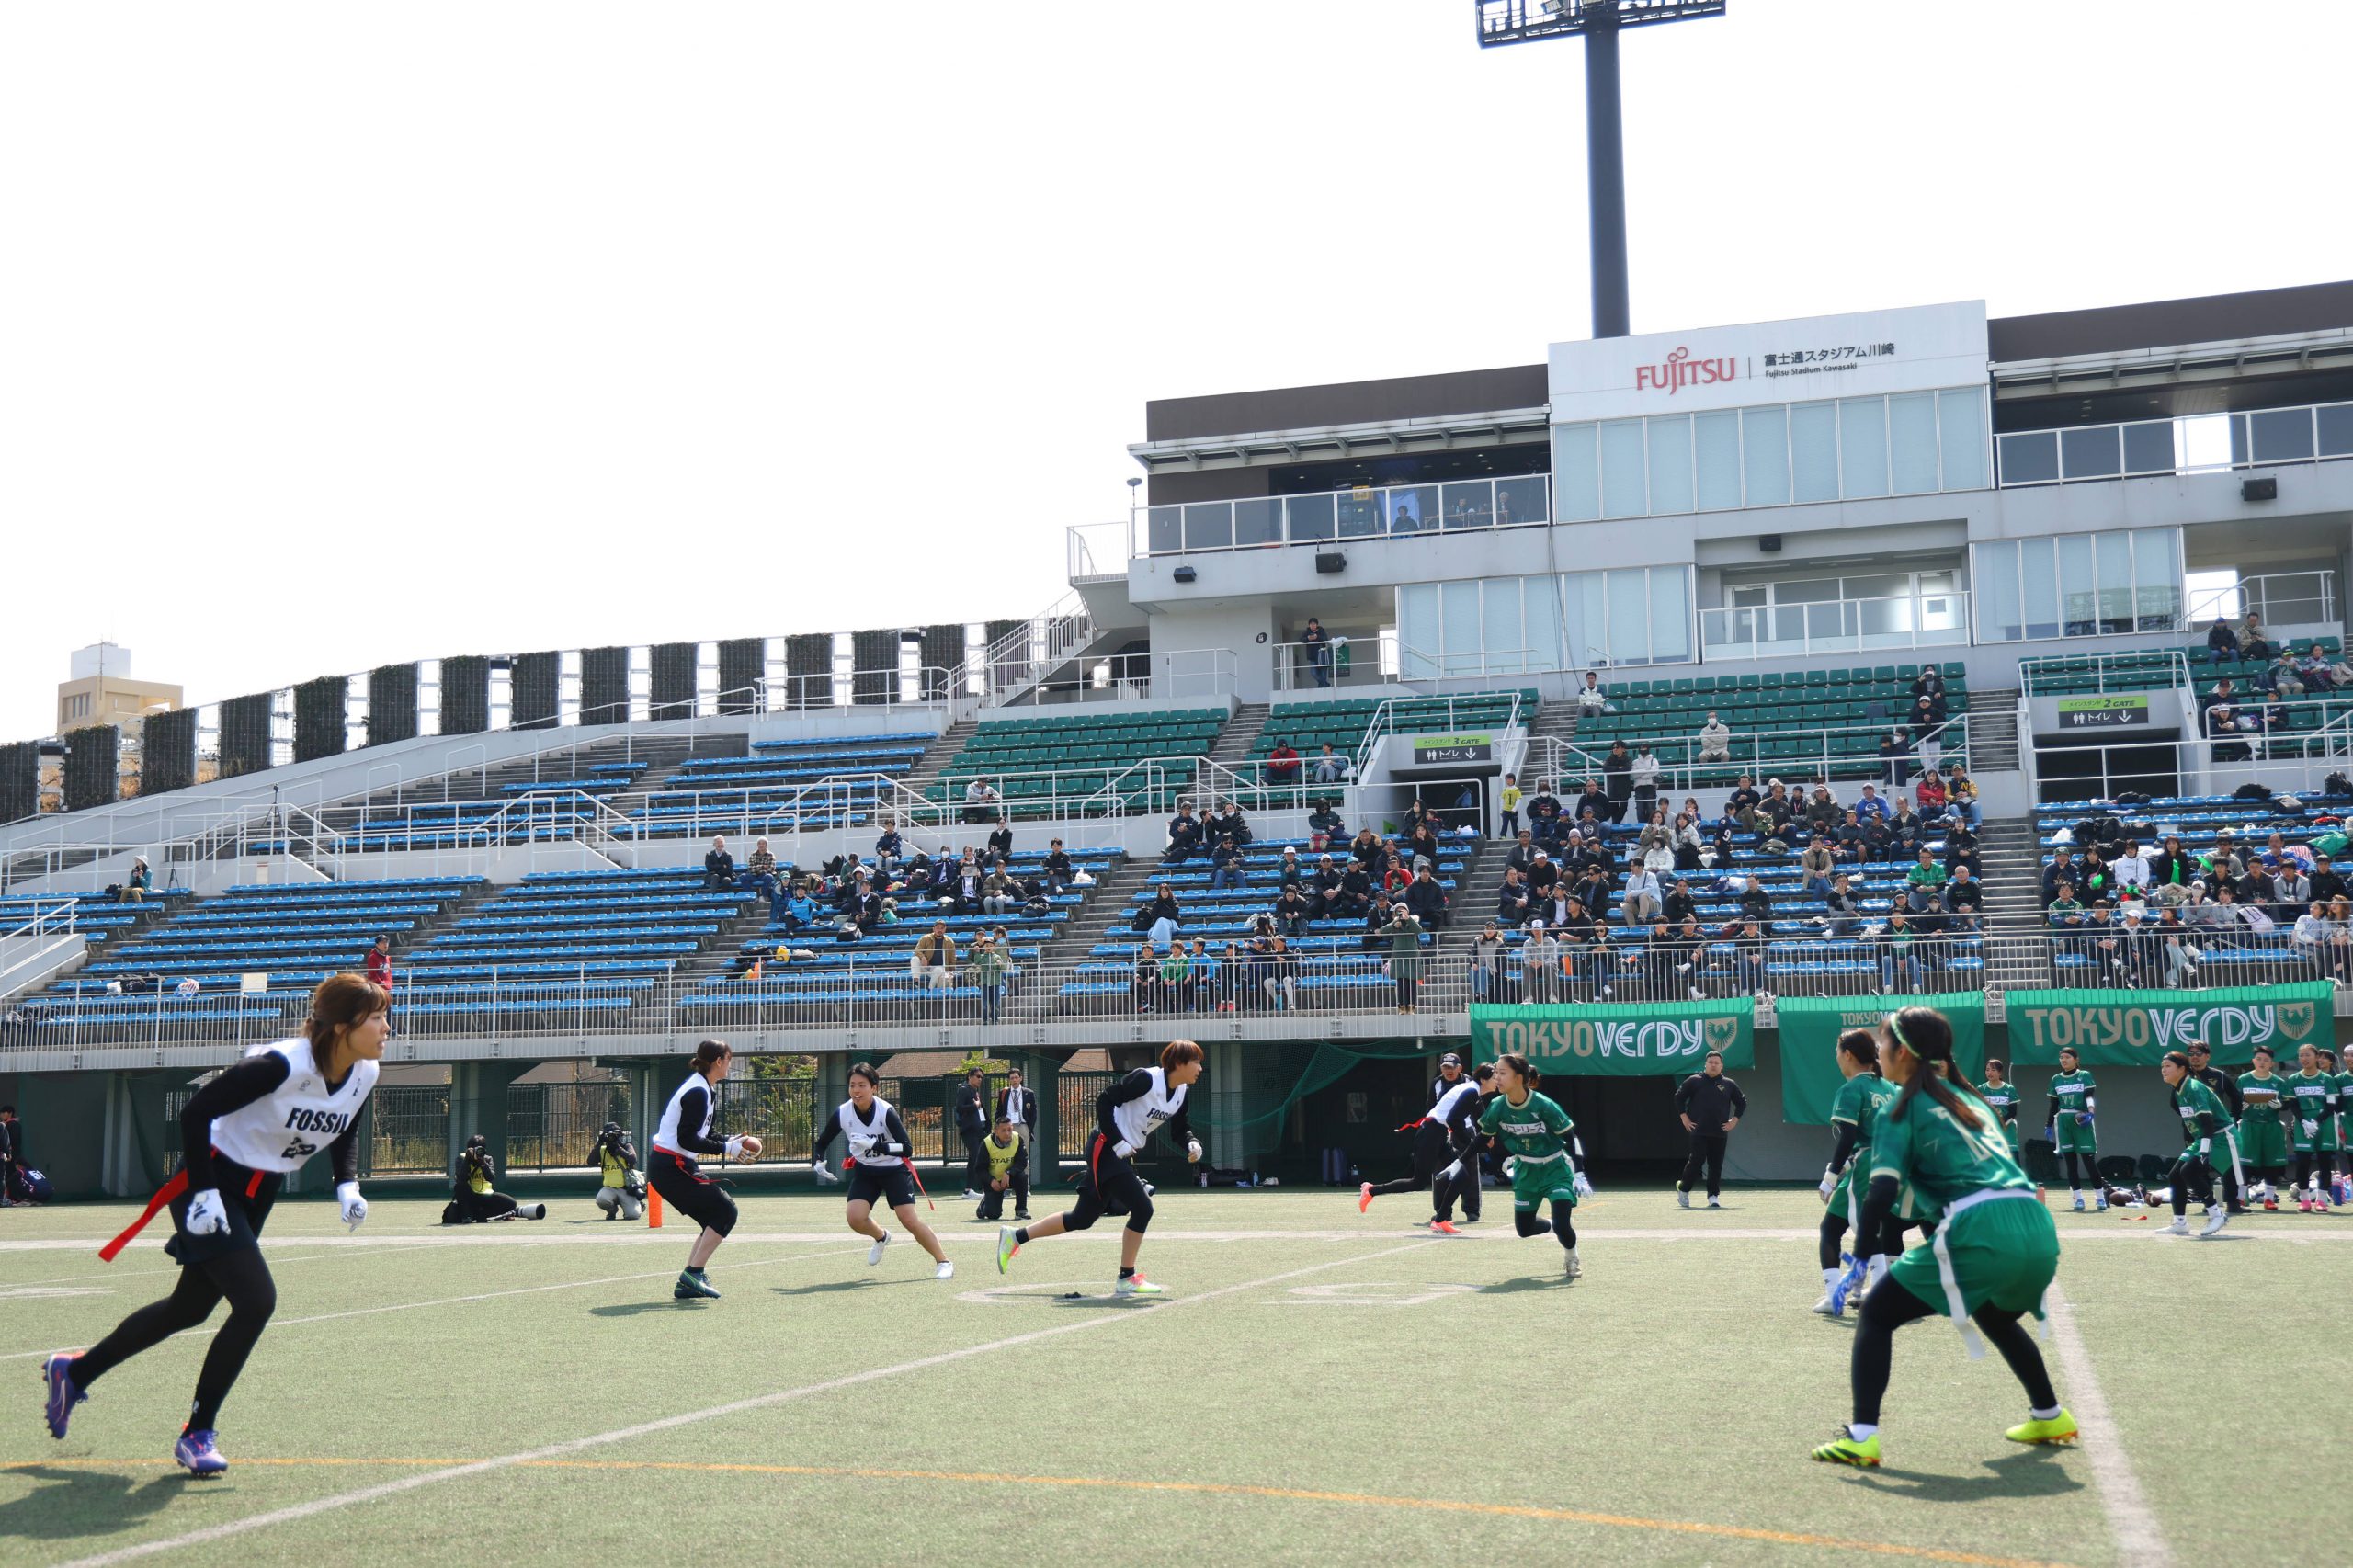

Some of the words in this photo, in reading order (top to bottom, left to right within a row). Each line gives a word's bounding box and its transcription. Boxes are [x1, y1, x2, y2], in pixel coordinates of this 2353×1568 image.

[1764, 343, 1895, 367] 富士通スタジアム川崎
[1636, 346, 1735, 395] FUJITSU
[1765, 369, 1790, 379] Fujitsu
[1790, 366, 1821, 375] Stadium
[1823, 362, 1858, 372] Kawasaki
[2103, 699, 2111, 708] 2
[2087, 712, 2111, 721] トイレ
[1722, 829, 1732, 842] 9
[1486, 1021, 1595, 1057] TOKYO
[2025, 1007, 2150, 1047] TOKYO
[285, 1107, 349, 1134] FOSSIL
